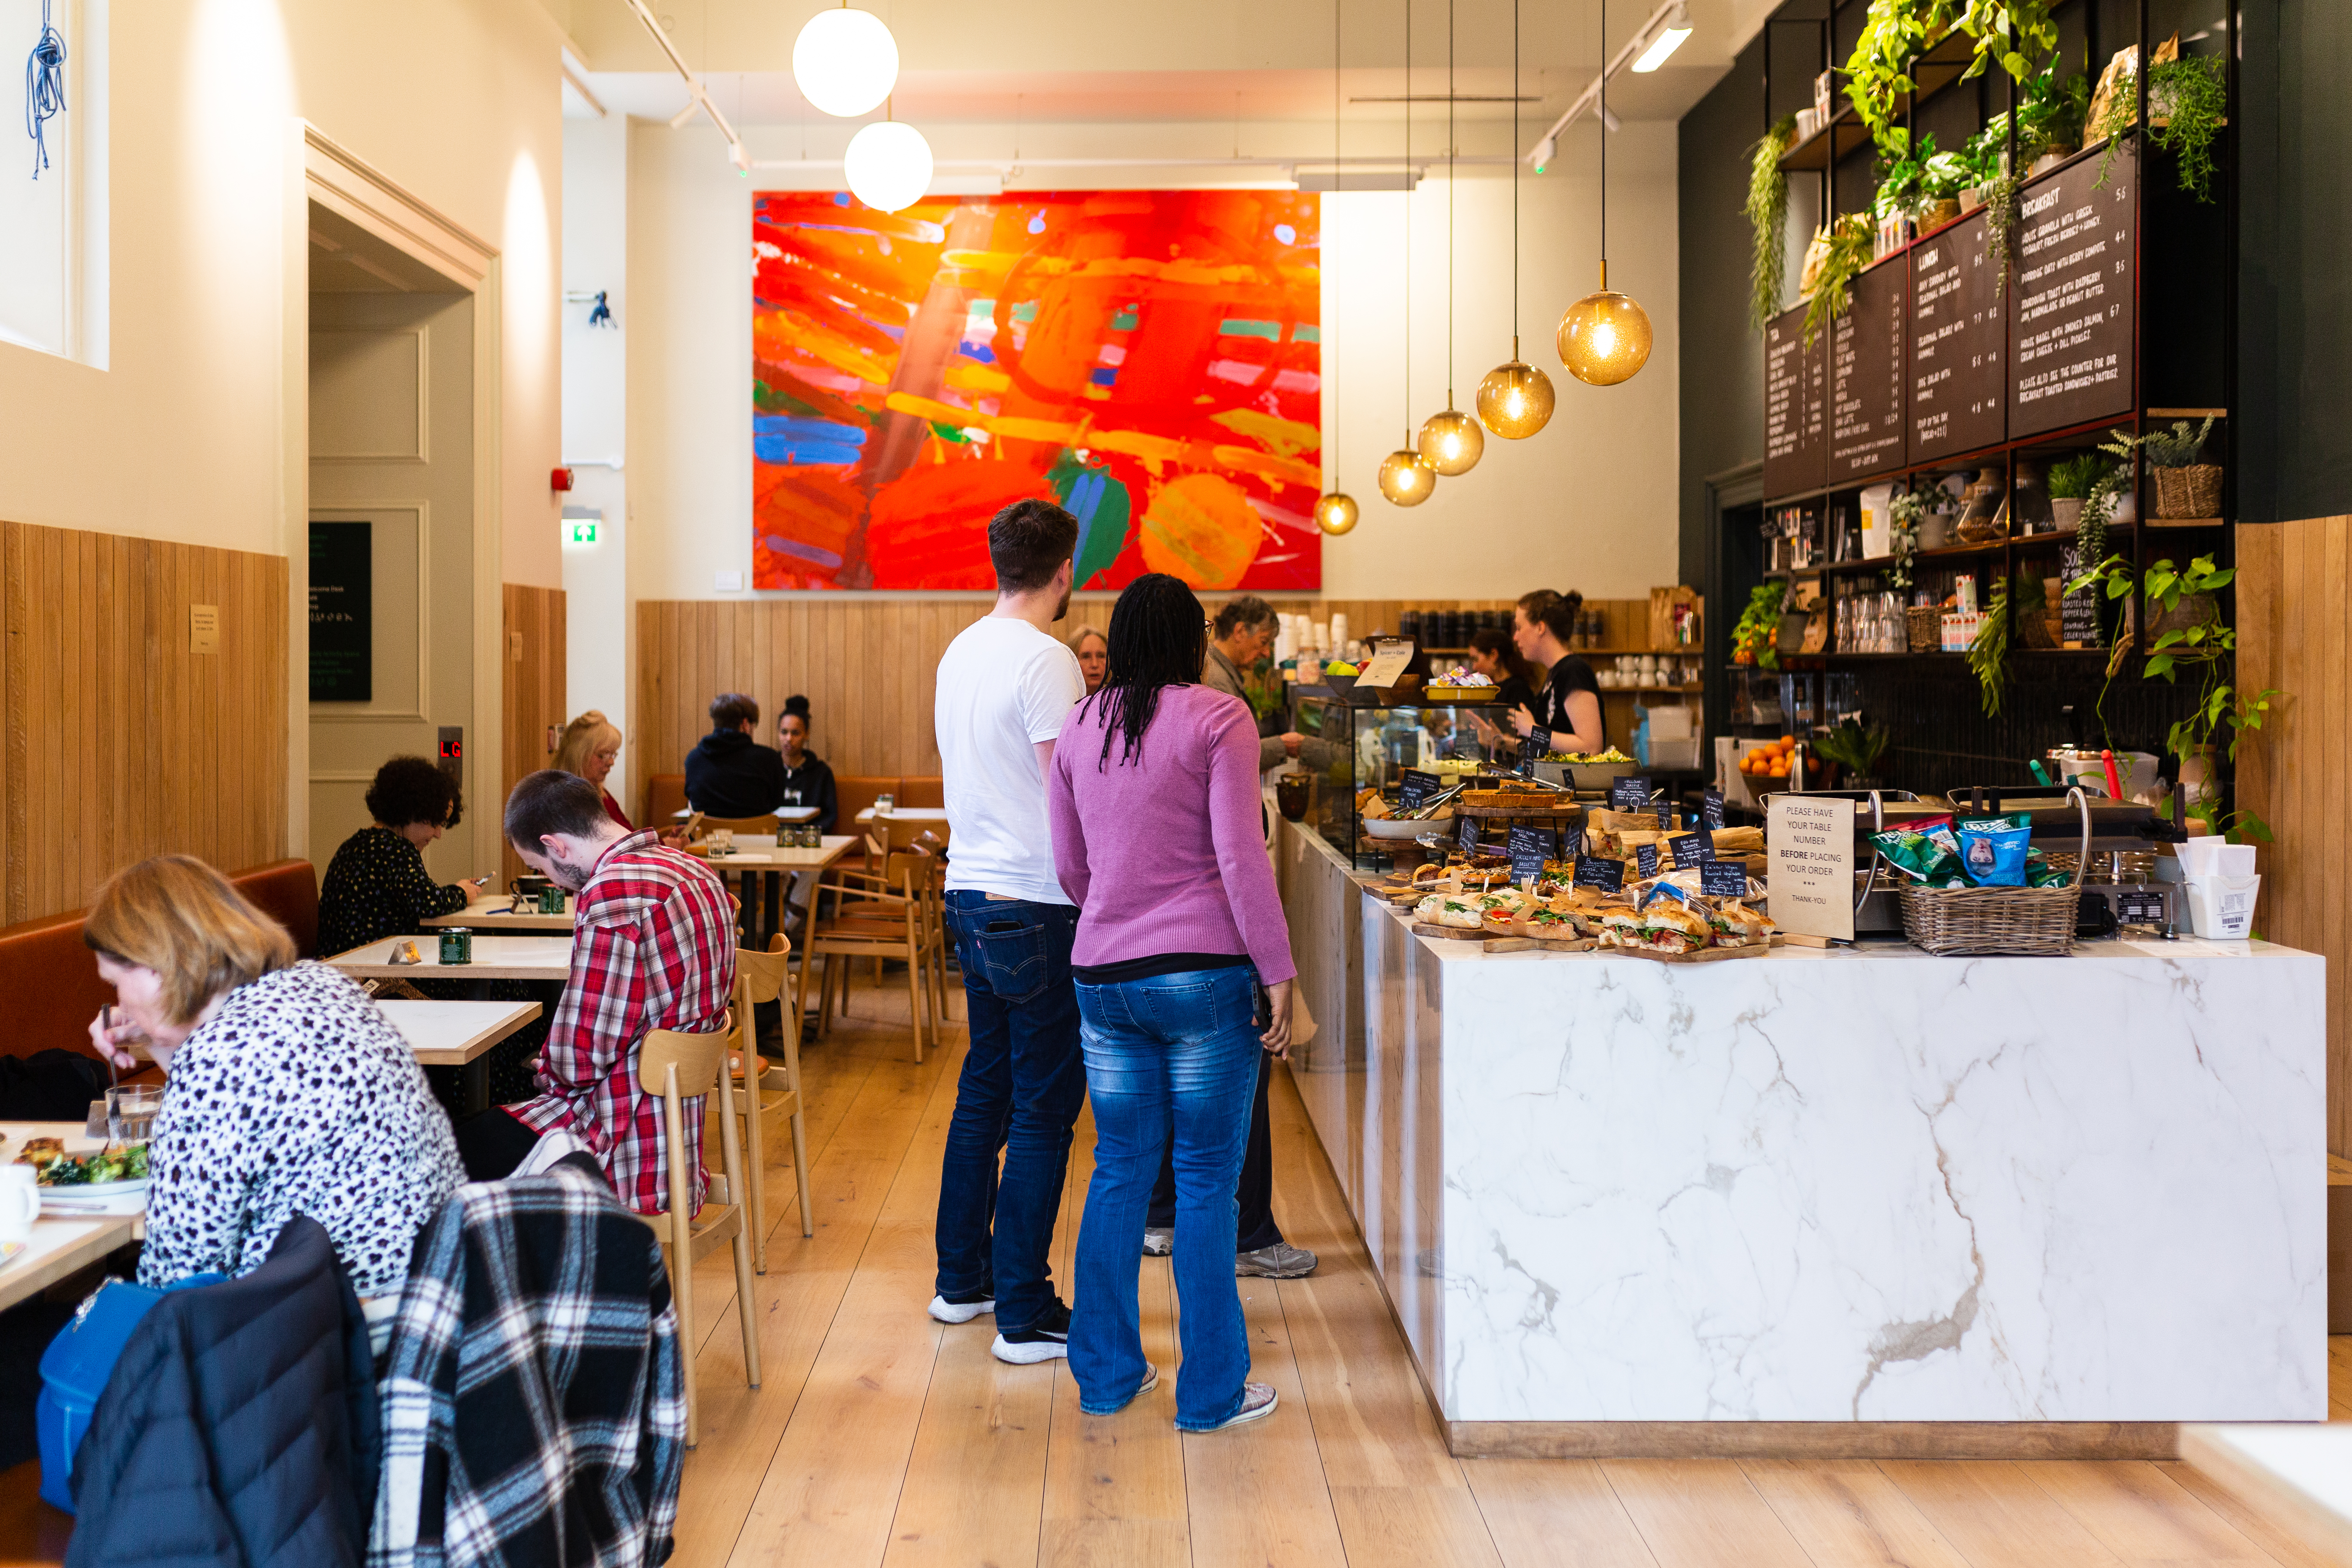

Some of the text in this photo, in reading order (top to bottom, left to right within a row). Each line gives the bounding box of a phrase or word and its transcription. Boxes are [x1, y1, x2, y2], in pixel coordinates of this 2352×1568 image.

[2022, 187, 2060, 220] BREAKFAST
[2022, 205, 2093, 244] HOUSE GRANOLA WITH GREEK
[2044, 233, 2059, 248] FRESH
[2060, 224, 2078, 240] BERRIES
[1919, 247, 1938, 272] LUNCH
[2022, 266, 2043, 284] PORRIDGE
[2044, 261, 2056, 275] OATS
[2057, 256, 2068, 269] WITH
[2069, 249, 2084, 266] BERRY
[1948, 264, 1959, 278] WITH
[2022, 270, 2101, 310] SOURDOUGH TOAST WITH RASPBERRY
[2031, 299, 2058, 319] MARMALADE
[2059, 297, 2066, 308] OR
[2066, 290, 2084, 305] PEANUT
[2021, 336, 2035, 349] HOUSE
[2036, 331, 2050, 345] BAGEL
[2052, 326, 2063, 338] WITH
[2065, 318, 2082, 334] SMOKED
[2021, 349, 2035, 363] CREAM
[2036, 342, 2053, 357] CHEESE
[2060, 338, 2069, 349] DILL
[2019, 354, 2116, 391] PLEASE ALSO SEE THE COUNTER FOR OUR
[2019, 388, 2044, 404] BREAKFAST
[2045, 383, 2063, 397] TOASTED
[2062, 568, 2069, 579] OF
[1786, 807, 1833, 818] PLEASE HAVE
[1787, 821, 1832, 831] YOUR TABLE
[1794, 835, 1826, 845] NUMBER
[1586, 858, 1609, 868] Baguette
[1780, 849, 1842, 862] BEFORE PLACING
[1725, 864, 1738, 873] Vegan
[1786, 864, 1833, 876] YOUR ORDER
[1792, 895, 1826, 905] THANK-YOU
